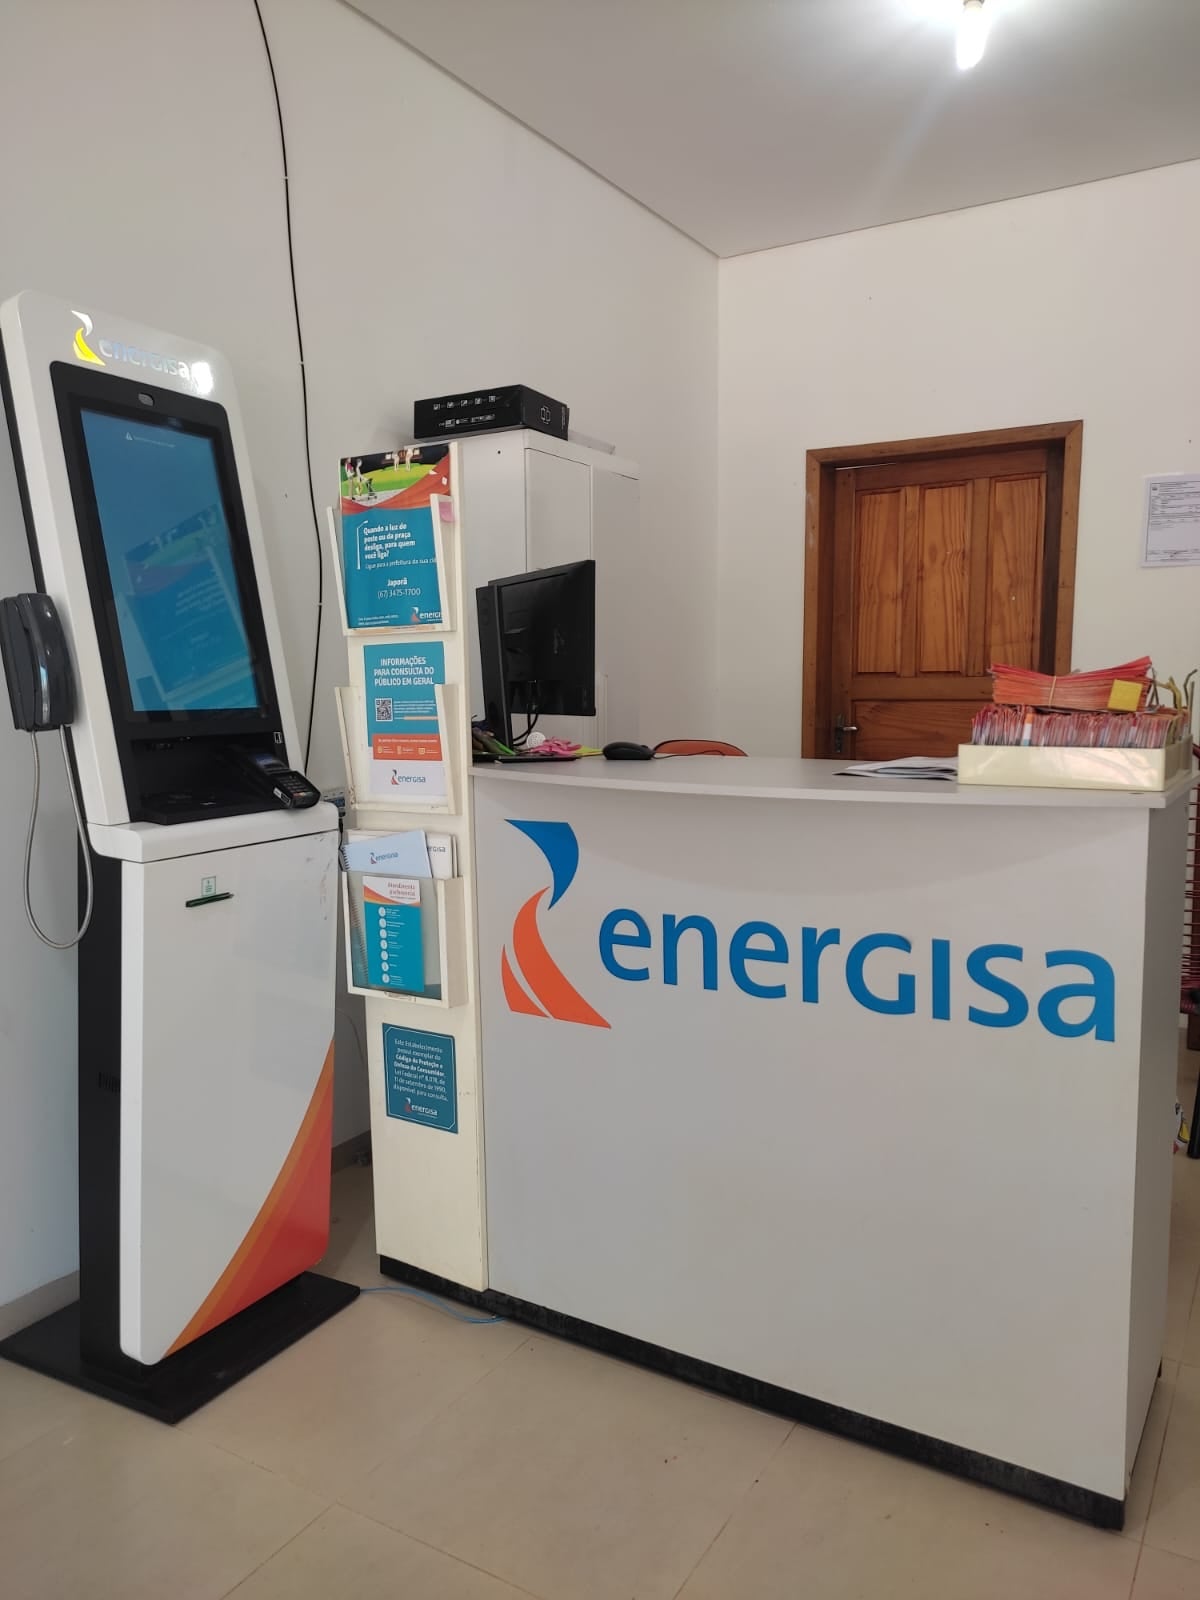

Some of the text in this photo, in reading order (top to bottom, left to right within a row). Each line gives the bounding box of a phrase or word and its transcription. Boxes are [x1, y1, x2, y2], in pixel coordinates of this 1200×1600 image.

[364, 524, 384, 535] Quando
[398, 540, 416, 549] quem
[377, 590, 388, 599] (67)
[380, 655, 426, 667] INFORMAÇÕES
[374, 666, 434, 676] PARA CONSULTA DO
[374, 676, 434, 687] PÚBLICO EM GERAL
[598, 907, 1116, 1043] energisa
